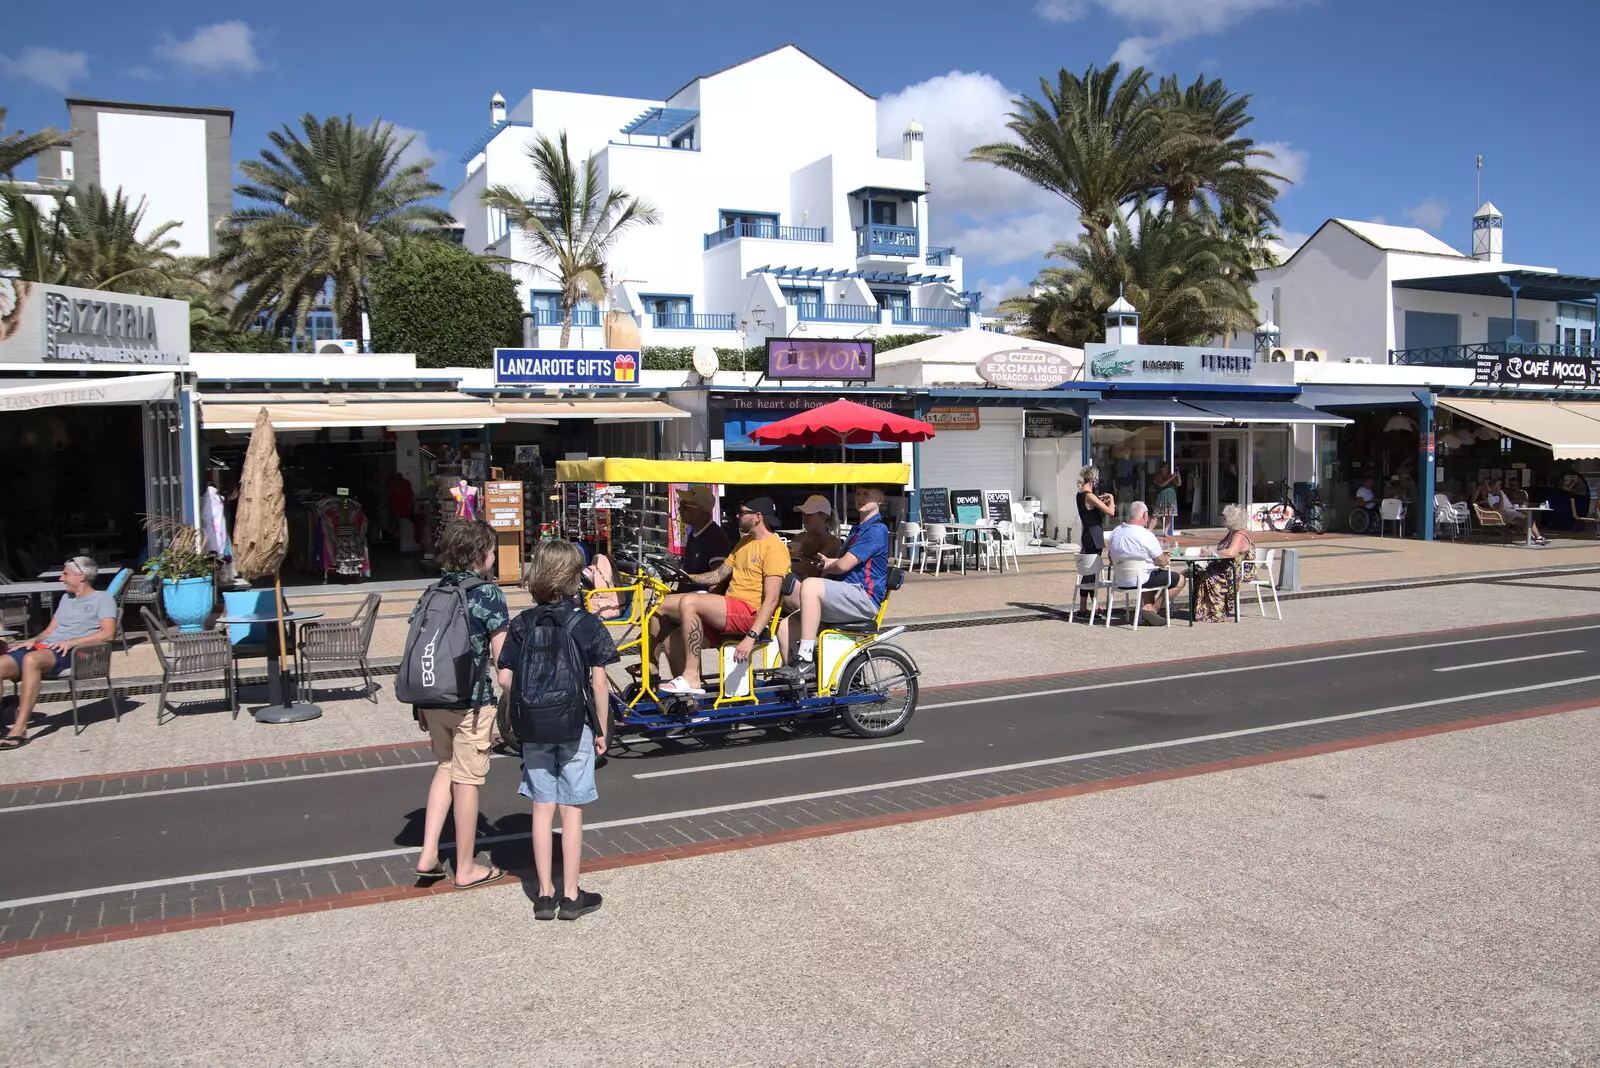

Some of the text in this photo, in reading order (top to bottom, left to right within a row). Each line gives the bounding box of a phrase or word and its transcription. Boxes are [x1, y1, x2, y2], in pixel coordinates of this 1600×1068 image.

[46, 292, 158, 358] PIZZERIA
[773, 349, 868, 371] DEVON
[1142, 360, 1184, 371] LACOSTE
[1201, 354, 1252, 370] FERRER
[500, 358, 611, 376] LANZAROTE GIFTS
[987, 363, 1068, 375] EXCHANGE
[1523, 360, 1549, 378] CAFÉ
[991, 373, 1027, 382] TOBACCO
[1034, 374, 1063, 382] LIQUOR
[41, 392, 60, 405] ZU
[61, 387, 106, 403] TEILEN
[733, 398, 752, 409] The
[757, 398, 785, 409] heart
[789, 398, 800, 409] of
[871, 398, 892, 409] food
[1028, 417, 1053, 425] FERRER
[956, 496, 979, 504] DEVON
[987, 492, 1009, 501] DEVON
